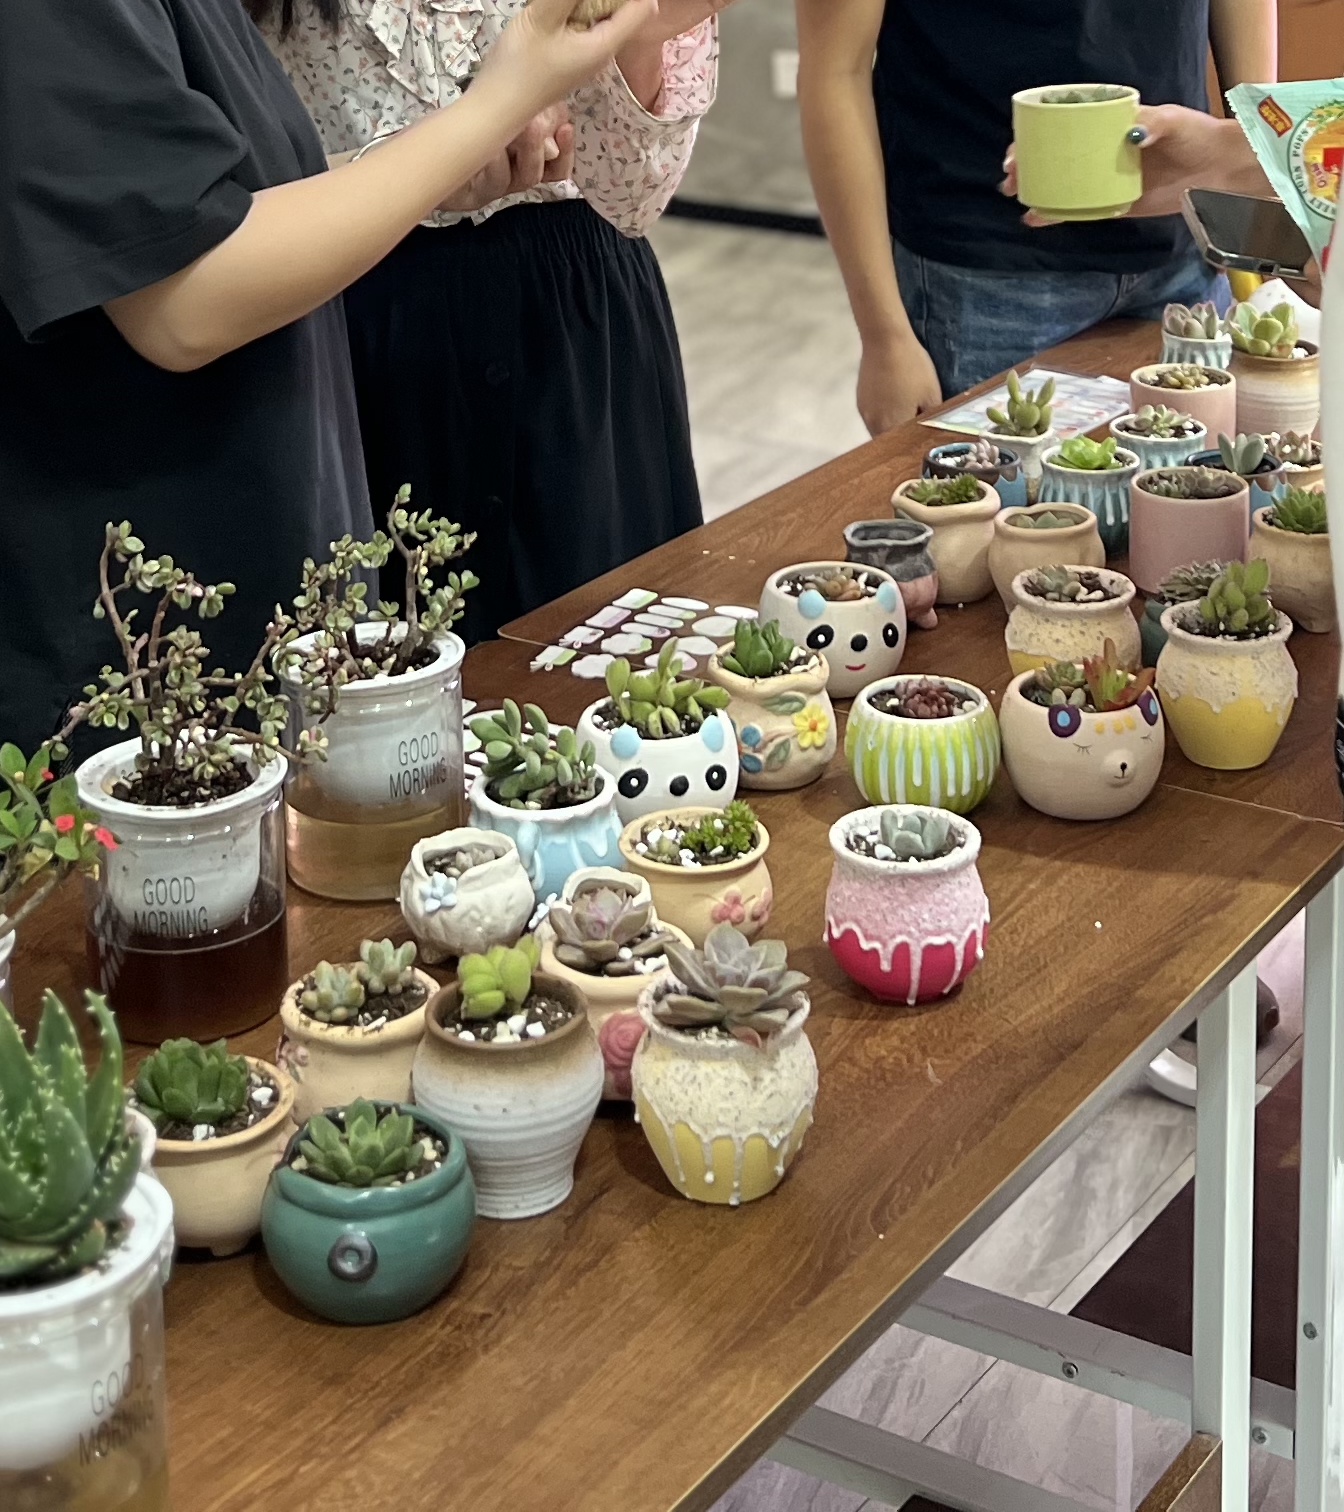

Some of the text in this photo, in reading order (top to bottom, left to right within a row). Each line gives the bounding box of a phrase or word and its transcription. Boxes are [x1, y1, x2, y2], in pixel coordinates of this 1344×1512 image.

[1292, 129, 1309, 158] POPS
[398, 731, 439, 766] GOOD
[388, 756, 447, 799] MORNING
[142, 876, 196, 906] GOOD
[133, 905, 209, 939] MORNING
[90, 1351, 144, 1418] GOOD
